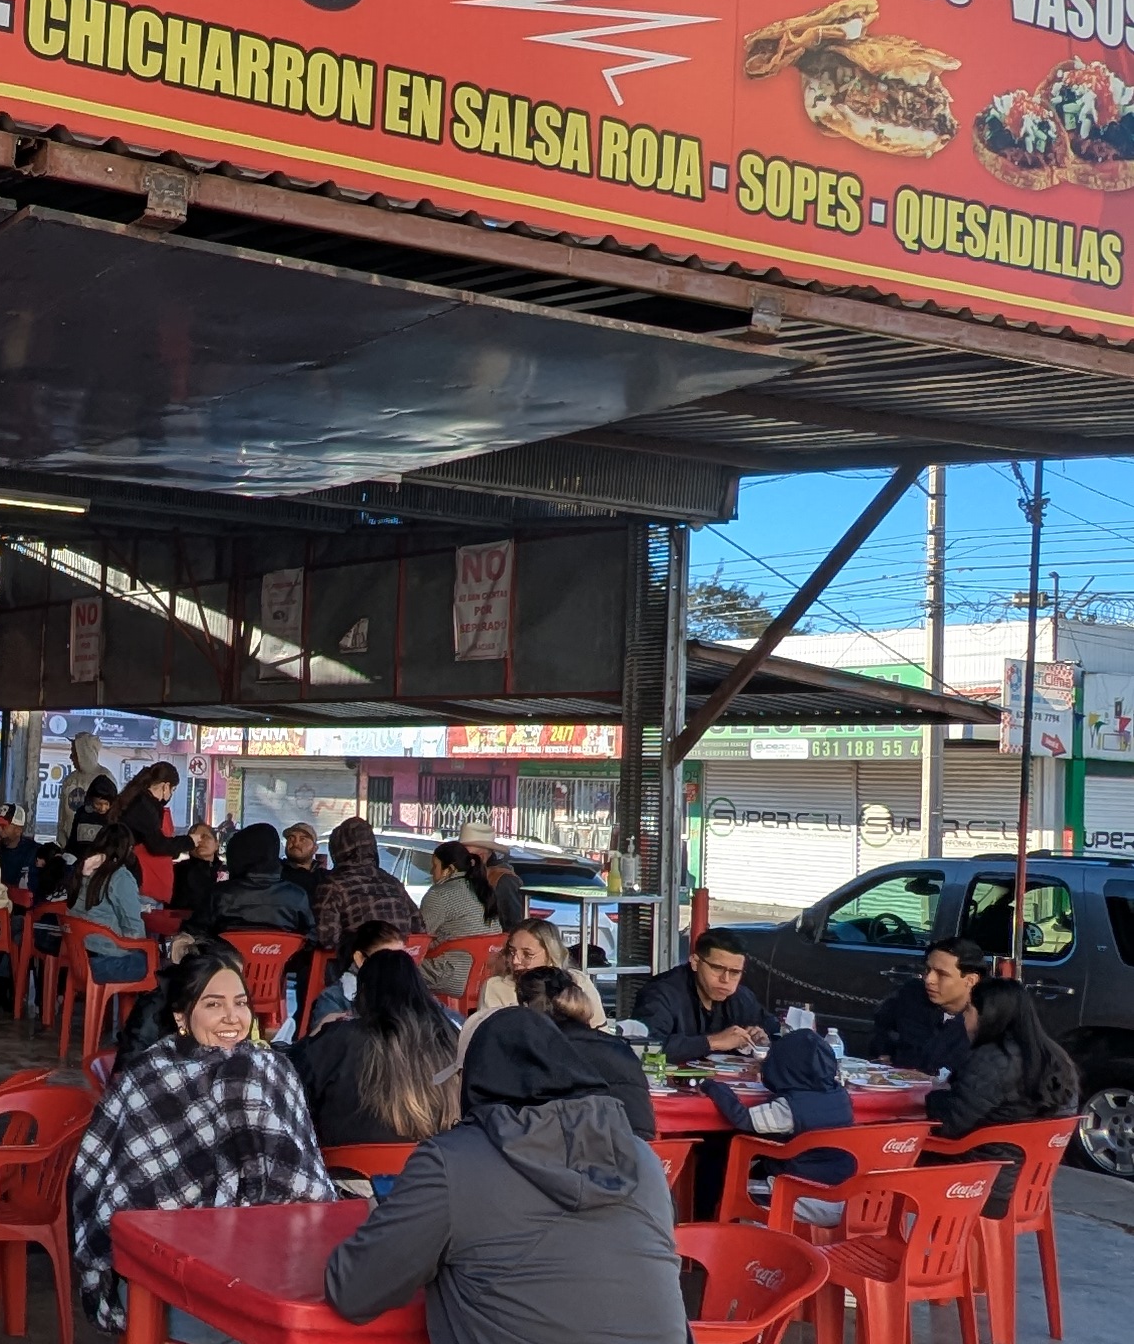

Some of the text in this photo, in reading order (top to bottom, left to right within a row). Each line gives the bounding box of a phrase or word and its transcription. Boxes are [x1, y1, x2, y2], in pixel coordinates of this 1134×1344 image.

[383, 58, 448, 142] EN
[450, 81, 591, 180] SALSA
[595, 118, 706, 202] ROJA
[736, 152, 865, 234] SOPES
[891, 186, 1125, 289] QUESADILLAS
[462, 550, 506, 584] NO
[76, 602, 98, 627] NO
[812, 740, 839, 756] 631
[846, 739, 874, 756] 188
[882, 739, 903, 756] 55
[910, 739, 922, 756] 4
